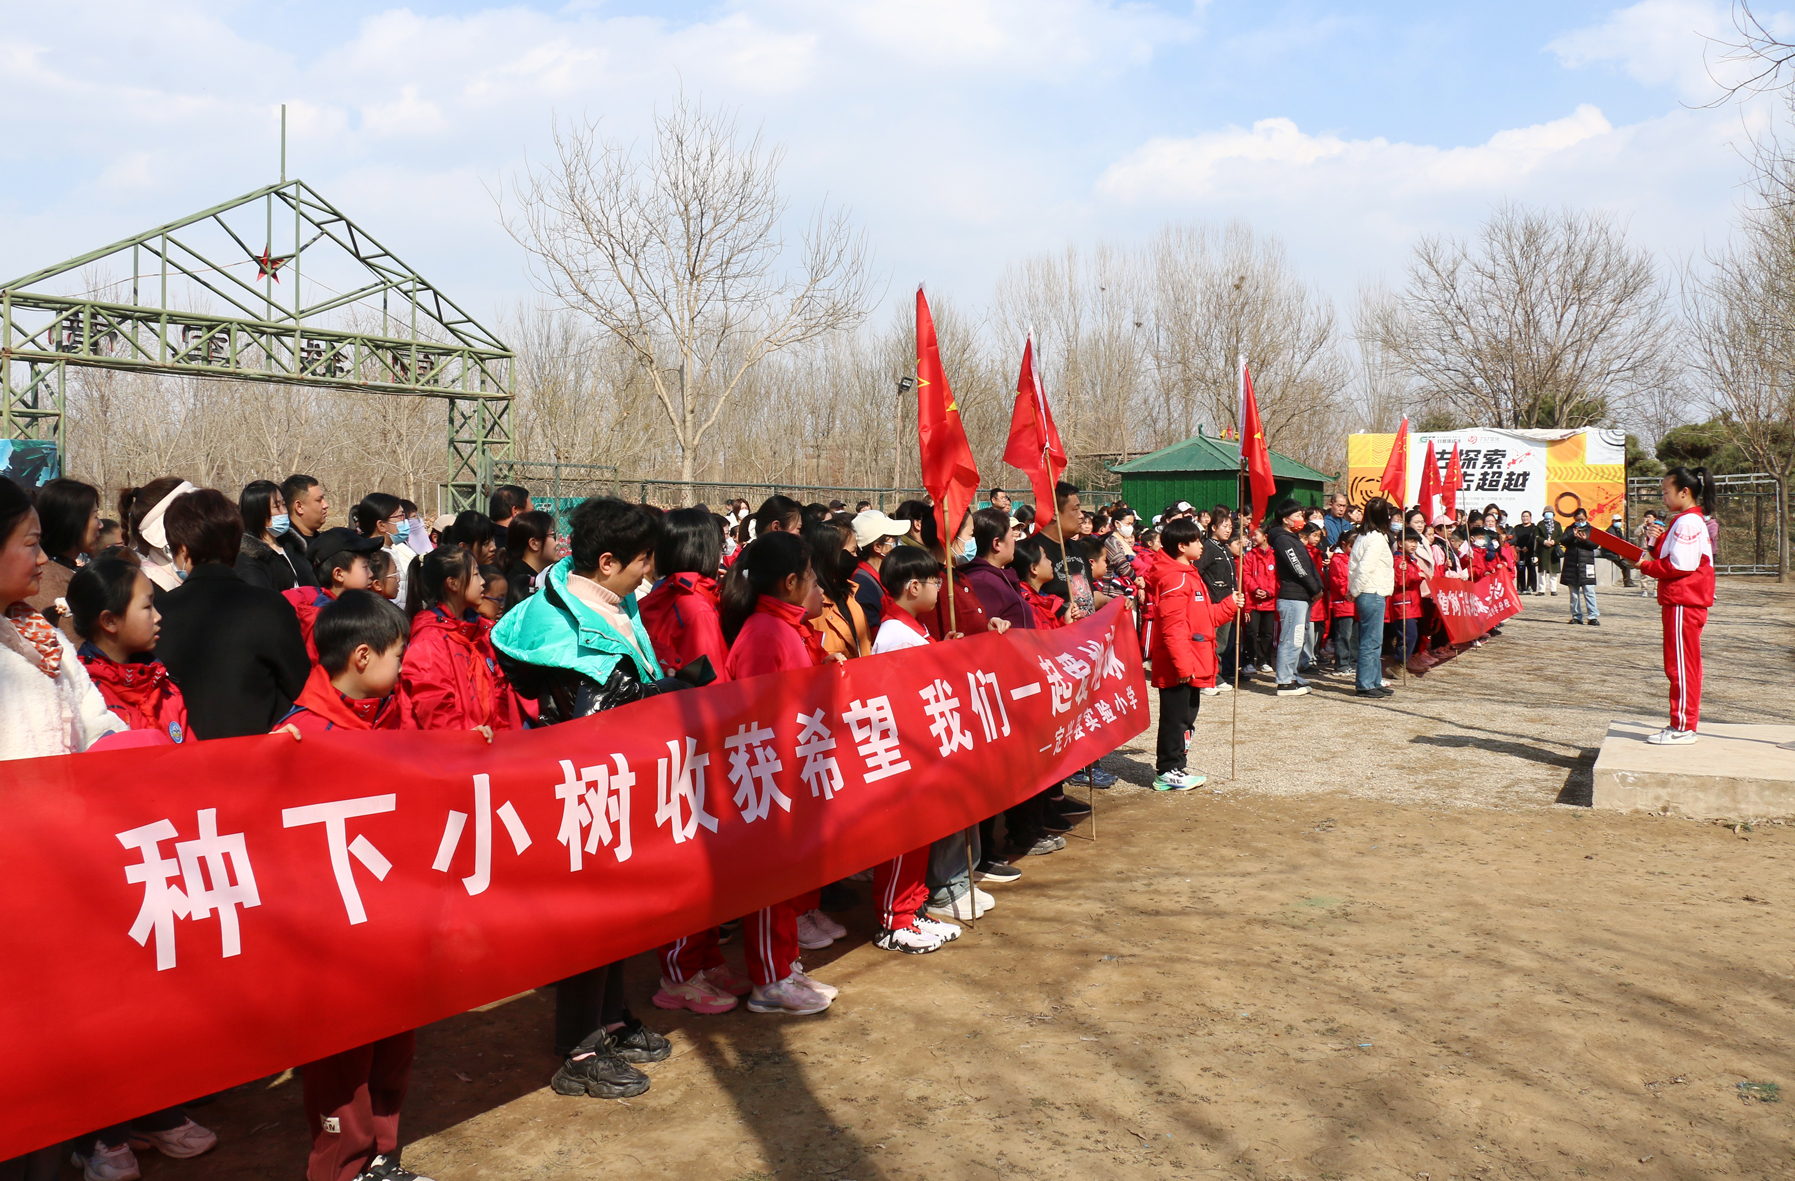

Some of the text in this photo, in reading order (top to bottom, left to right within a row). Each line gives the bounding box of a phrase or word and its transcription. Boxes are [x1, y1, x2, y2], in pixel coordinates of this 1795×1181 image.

[116, 694, 912, 971] 种下小树收获希望
